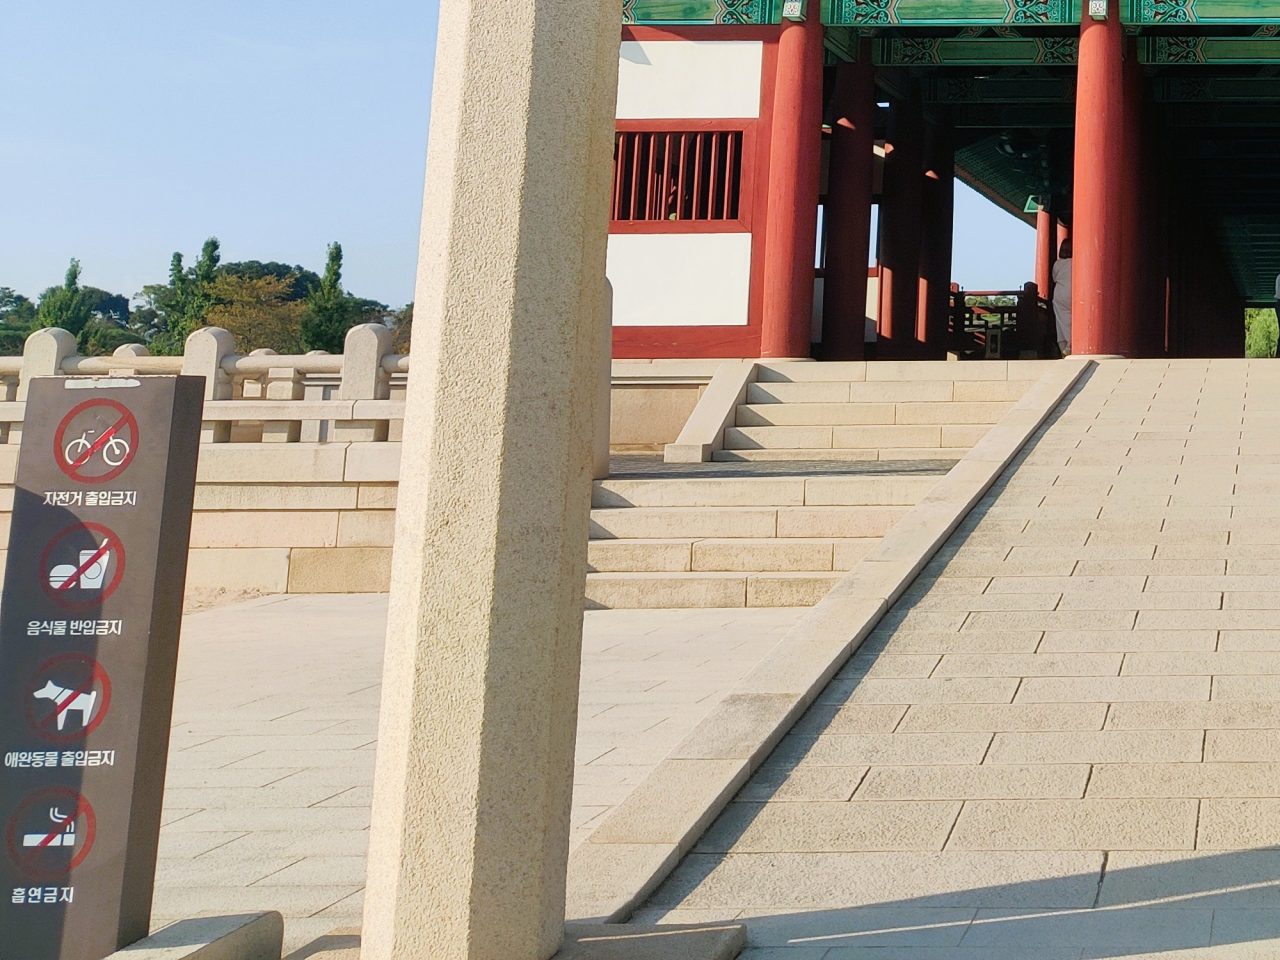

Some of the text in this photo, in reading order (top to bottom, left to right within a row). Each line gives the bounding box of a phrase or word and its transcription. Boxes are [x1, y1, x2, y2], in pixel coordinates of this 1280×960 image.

[43, 490, 137, 506] 자전거 출입금지
[26, 619, 123, 636] 음식물 반입금지
[4, 750, 115, 768] 애완동물 출입금지
[11, 886, 75, 904] 흡연금지
